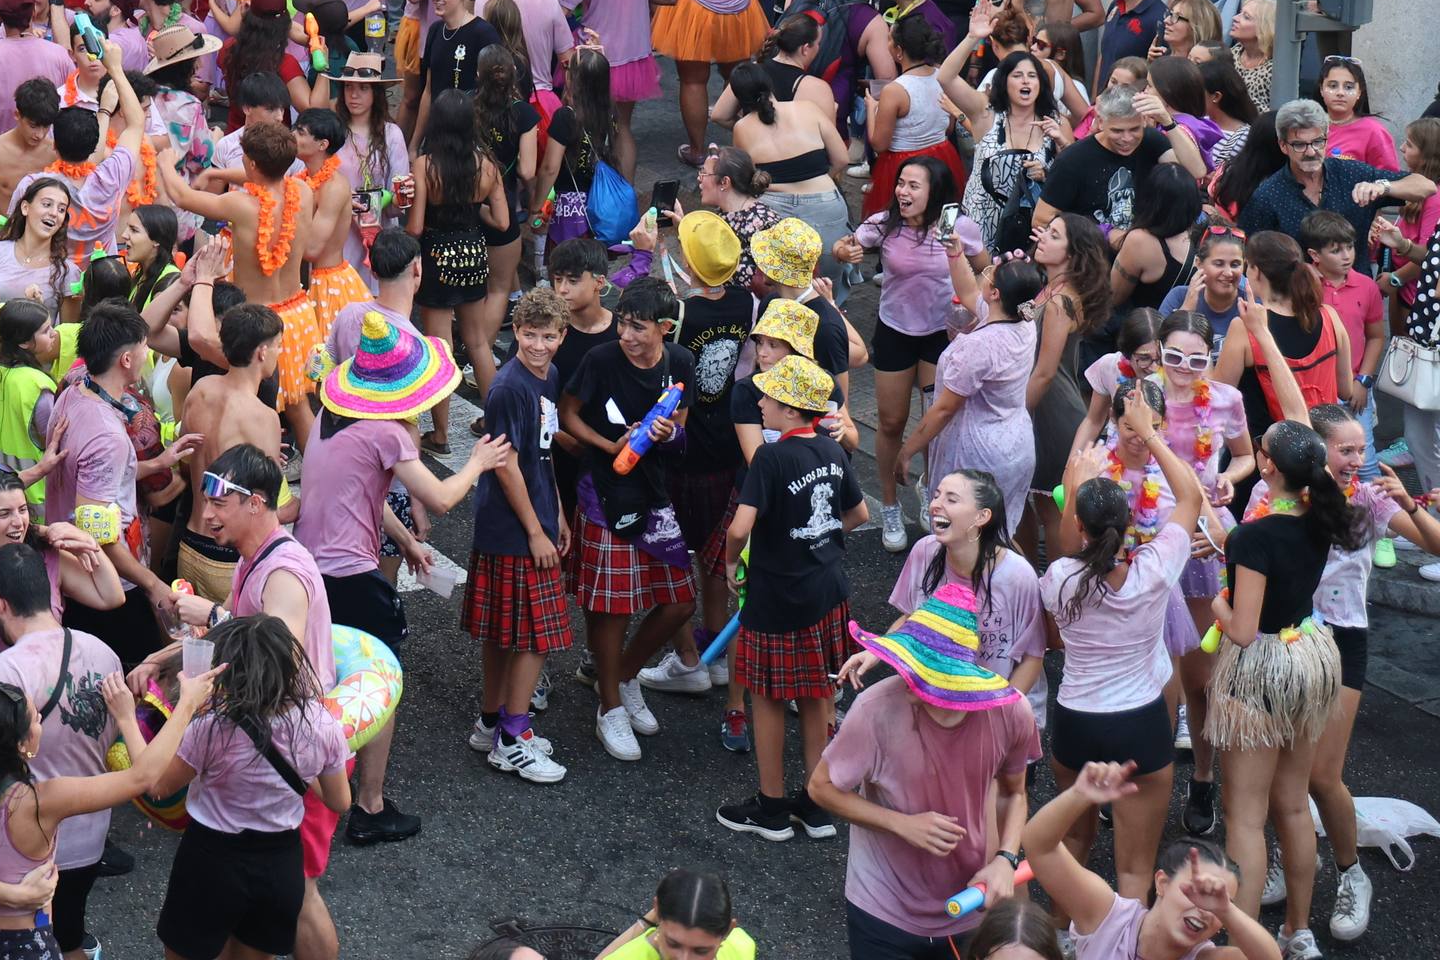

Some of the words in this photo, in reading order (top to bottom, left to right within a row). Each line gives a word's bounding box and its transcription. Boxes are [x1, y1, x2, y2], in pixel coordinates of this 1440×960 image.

[787, 470, 817, 495] HIJOS
[816, 466, 828, 479] DE
[994, 617, 1003, 627] H
[996, 648, 1008, 659] Z
